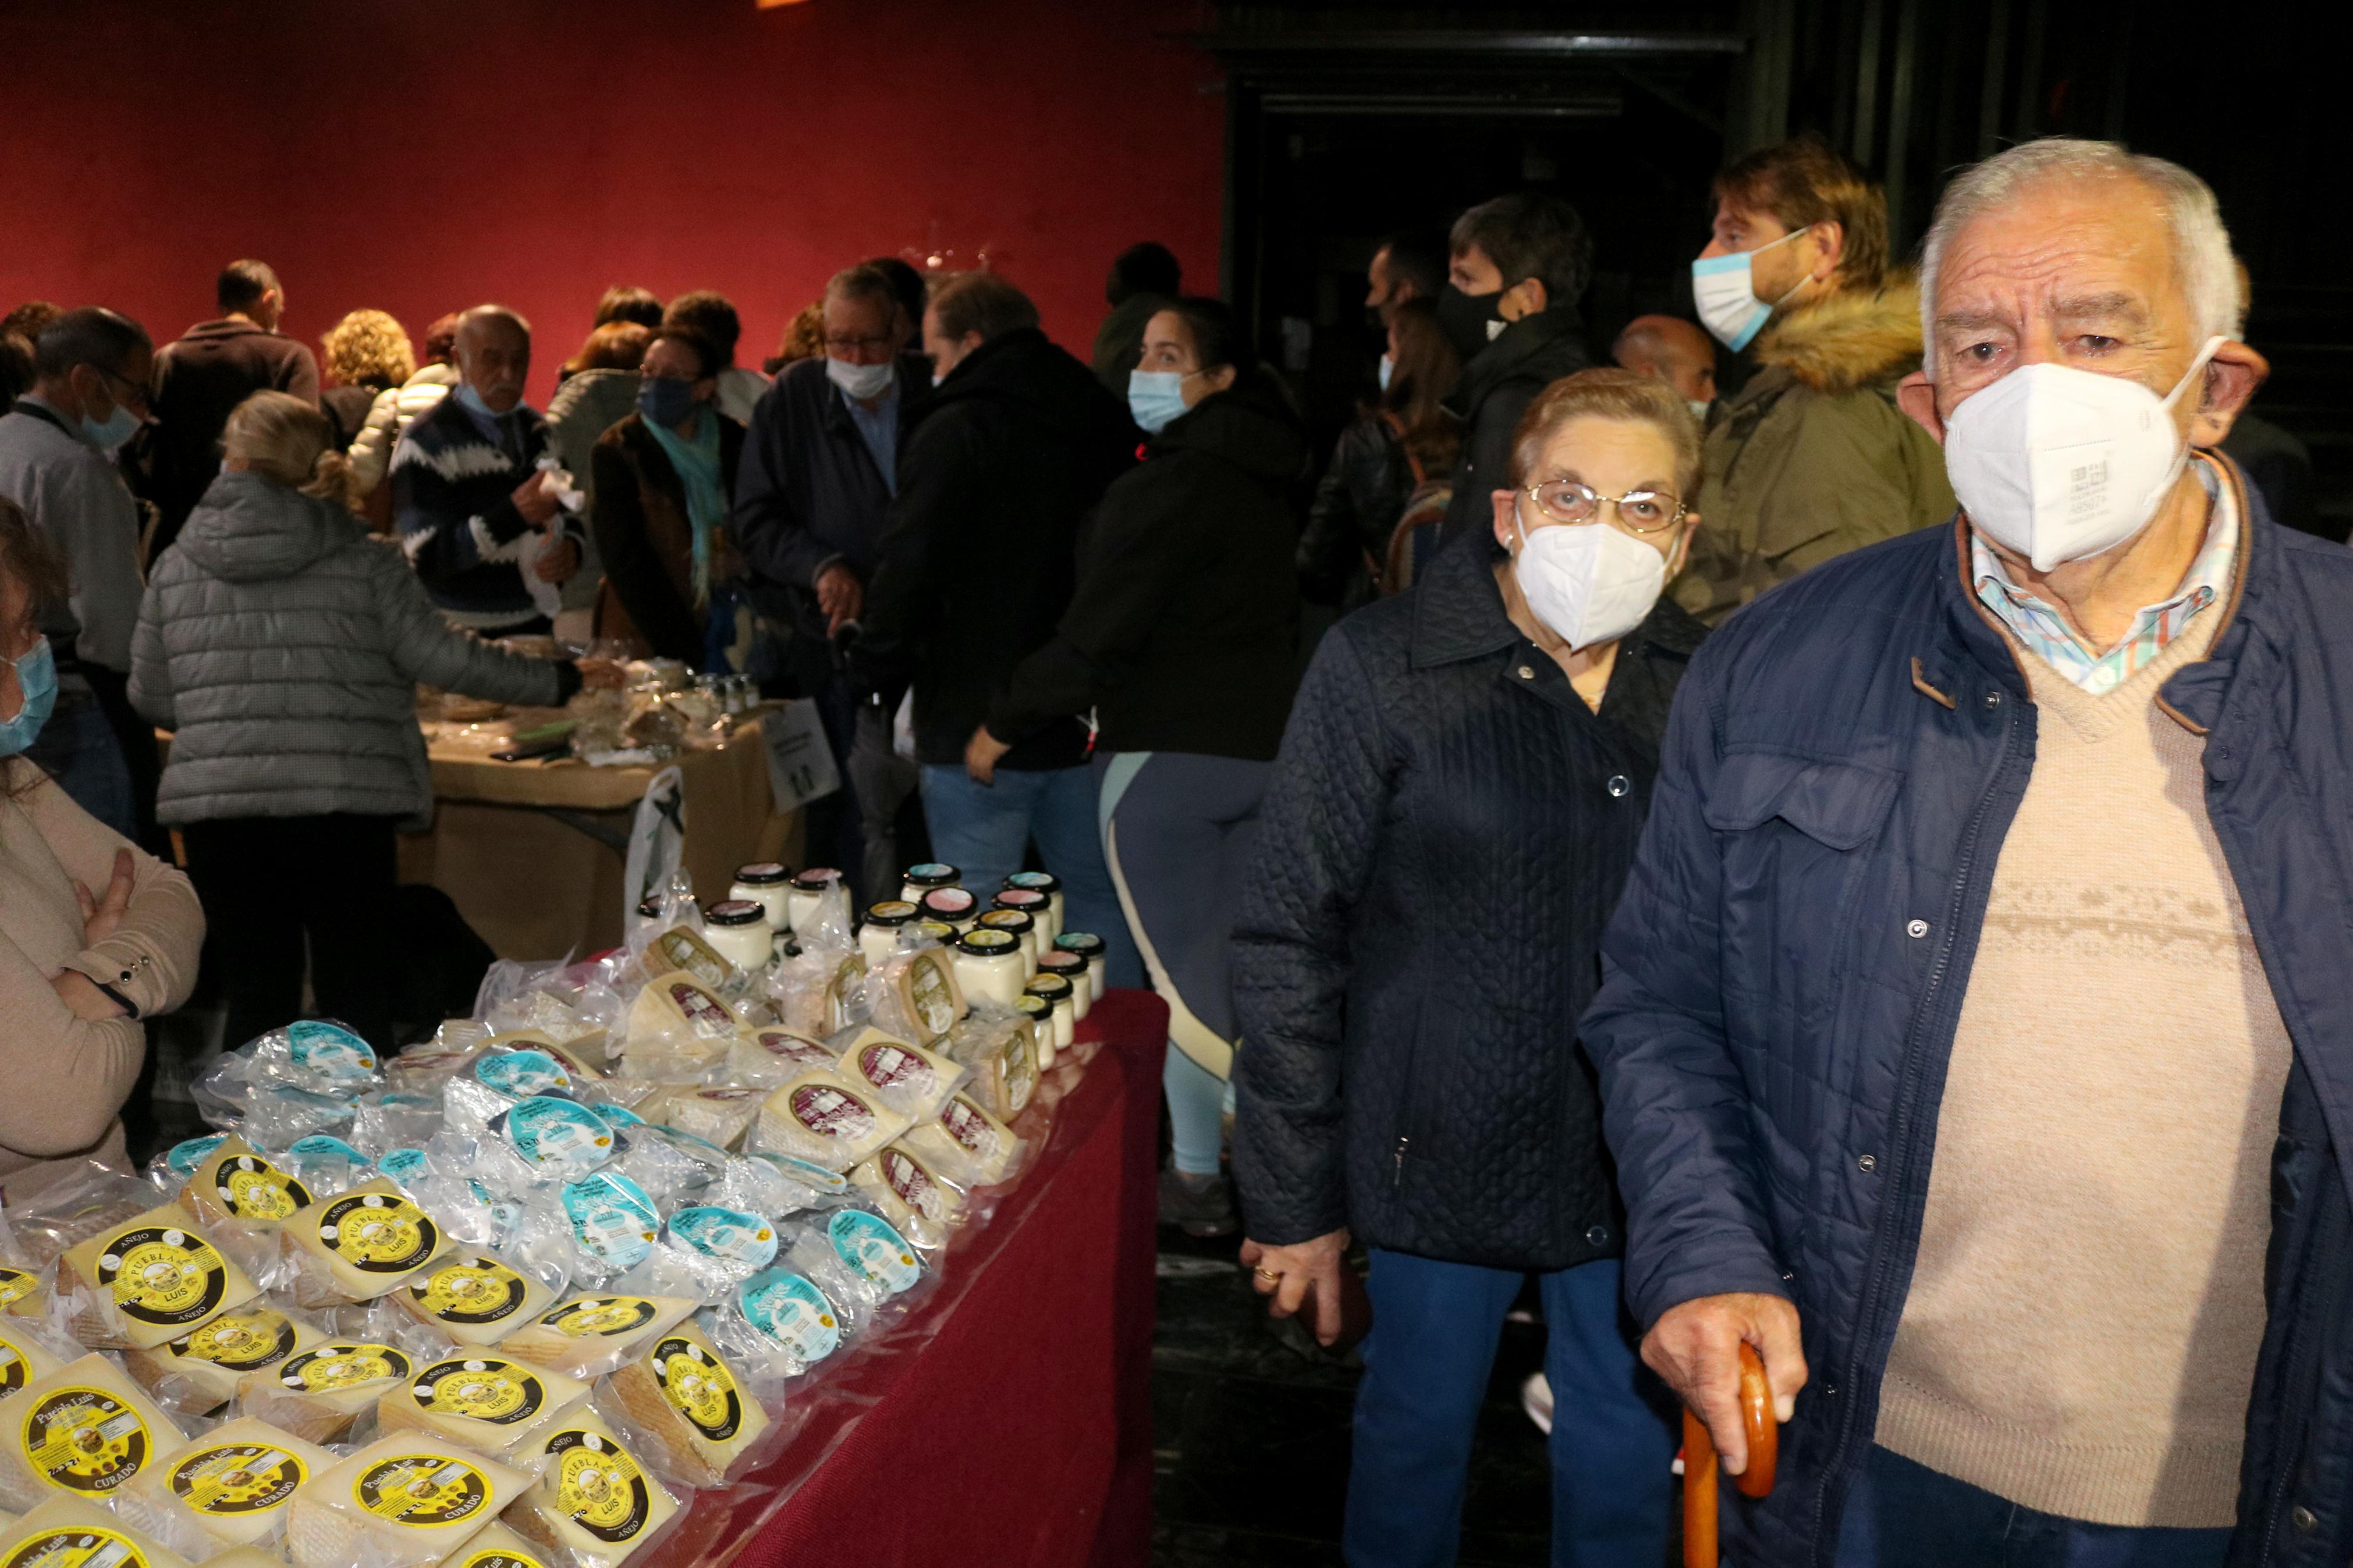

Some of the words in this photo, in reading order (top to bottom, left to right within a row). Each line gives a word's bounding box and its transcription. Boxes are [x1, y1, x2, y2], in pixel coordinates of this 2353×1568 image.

[275, 1205, 287, 1218] LUIS
[331, 1202, 352, 1219] AÑEJO
[350, 1215, 383, 1238] PUEBLA
[120, 1233, 150, 1249] AÑEJO
[388, 1238, 407, 1253] LUIS
[131, 1253, 175, 1275] PUEBLA
[409, 1249, 430, 1267] AÑEJO
[164, 1287, 188, 1302] LUIS
[474, 1293, 494, 1305] LUIS
[177, 1306, 207, 1322] AÑEJO
[492, 1304, 515, 1319] AÑEJO
[201, 1322, 239, 1343] PUEBLA
[241, 1342, 262, 1354] LUIS
[662, 1343, 678, 1353] AÑEJO
[260, 1351, 284, 1367] AÑEJO
[360, 1369, 378, 1381] LUIS
[426, 1366, 451, 1381] AÑEJO
[446, 1378, 483, 1396] PUEBLA
[36, 1401, 70, 1424] Puebla
[70, 1392, 95, 1406] Luis
[487, 1396, 509, 1410] LUIS
[701, 1404, 716, 1416] LUIS
[508, 1406, 533, 1422] AÑEJO
[716, 1426, 733, 1438] AÑEJO
[551, 1435, 572, 1452] AÑEJO
[177, 1457, 211, 1480] Puebla
[211, 1447, 234, 1462] Luis
[567, 1458, 599, 1484] PUEBLA
[94, 1462, 137, 1489] CURADO
[363, 1469, 395, 1489] Puebla
[392, 1459, 415, 1471] Luis
[254, 1481, 296, 1507] CURADO
[443, 1494, 481, 1520] CURADO
[601, 1498, 620, 1514] LUIS
[617, 1520, 638, 1538] AÑEJO
[40, 1534, 69, 1553] Luis
